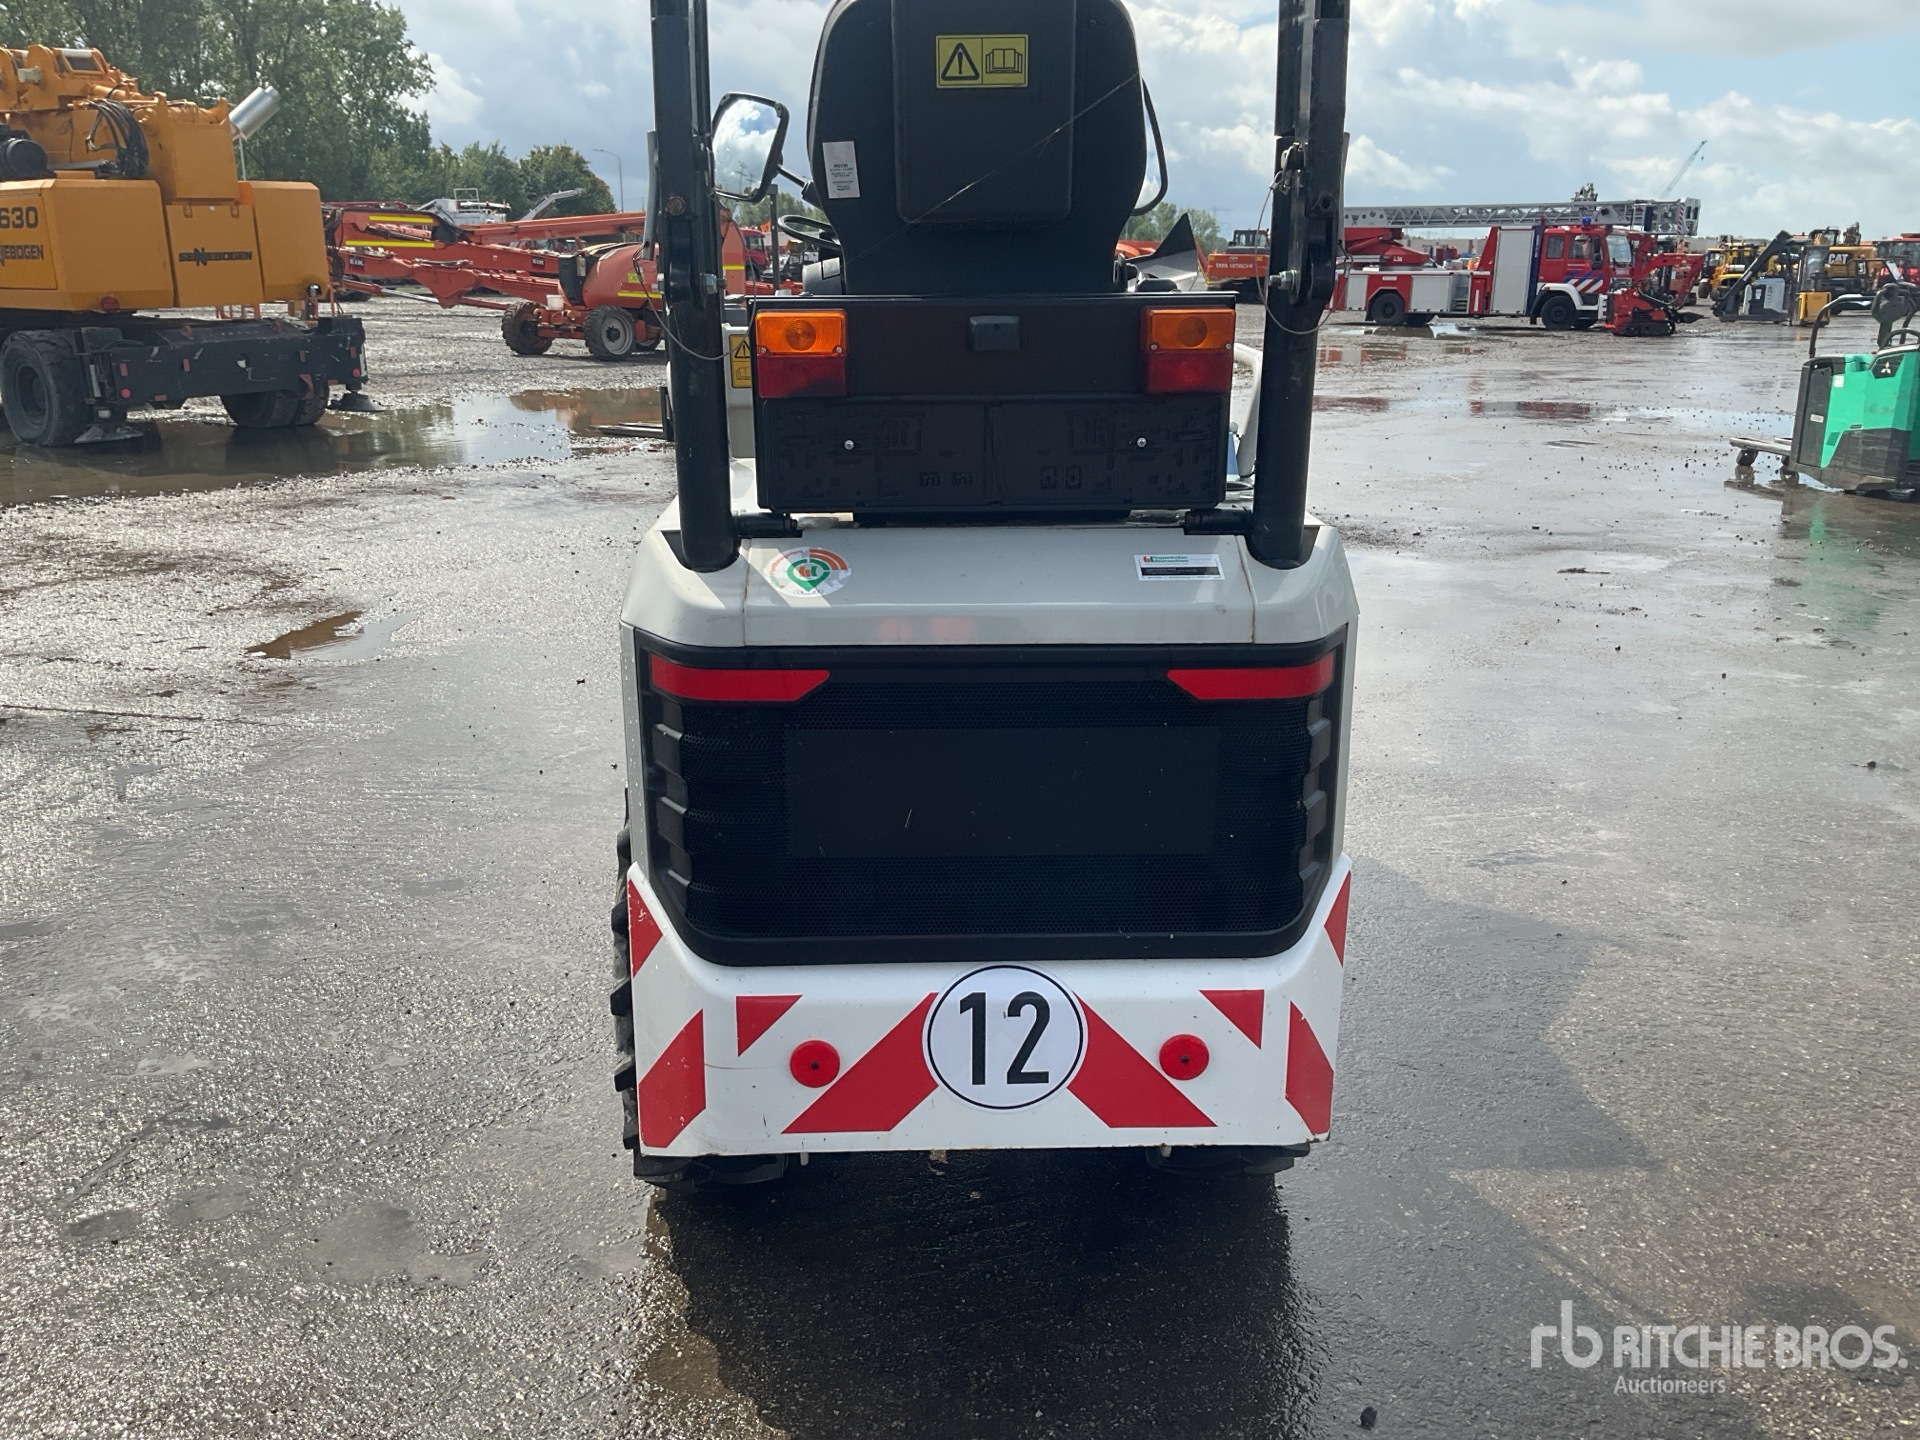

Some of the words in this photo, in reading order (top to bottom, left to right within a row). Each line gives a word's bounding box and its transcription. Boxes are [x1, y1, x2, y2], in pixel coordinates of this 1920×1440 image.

[0, 206, 38, 229] 630
[1828, 253, 1849, 265] CAT
[959, 991, 1050, 1086] 12
